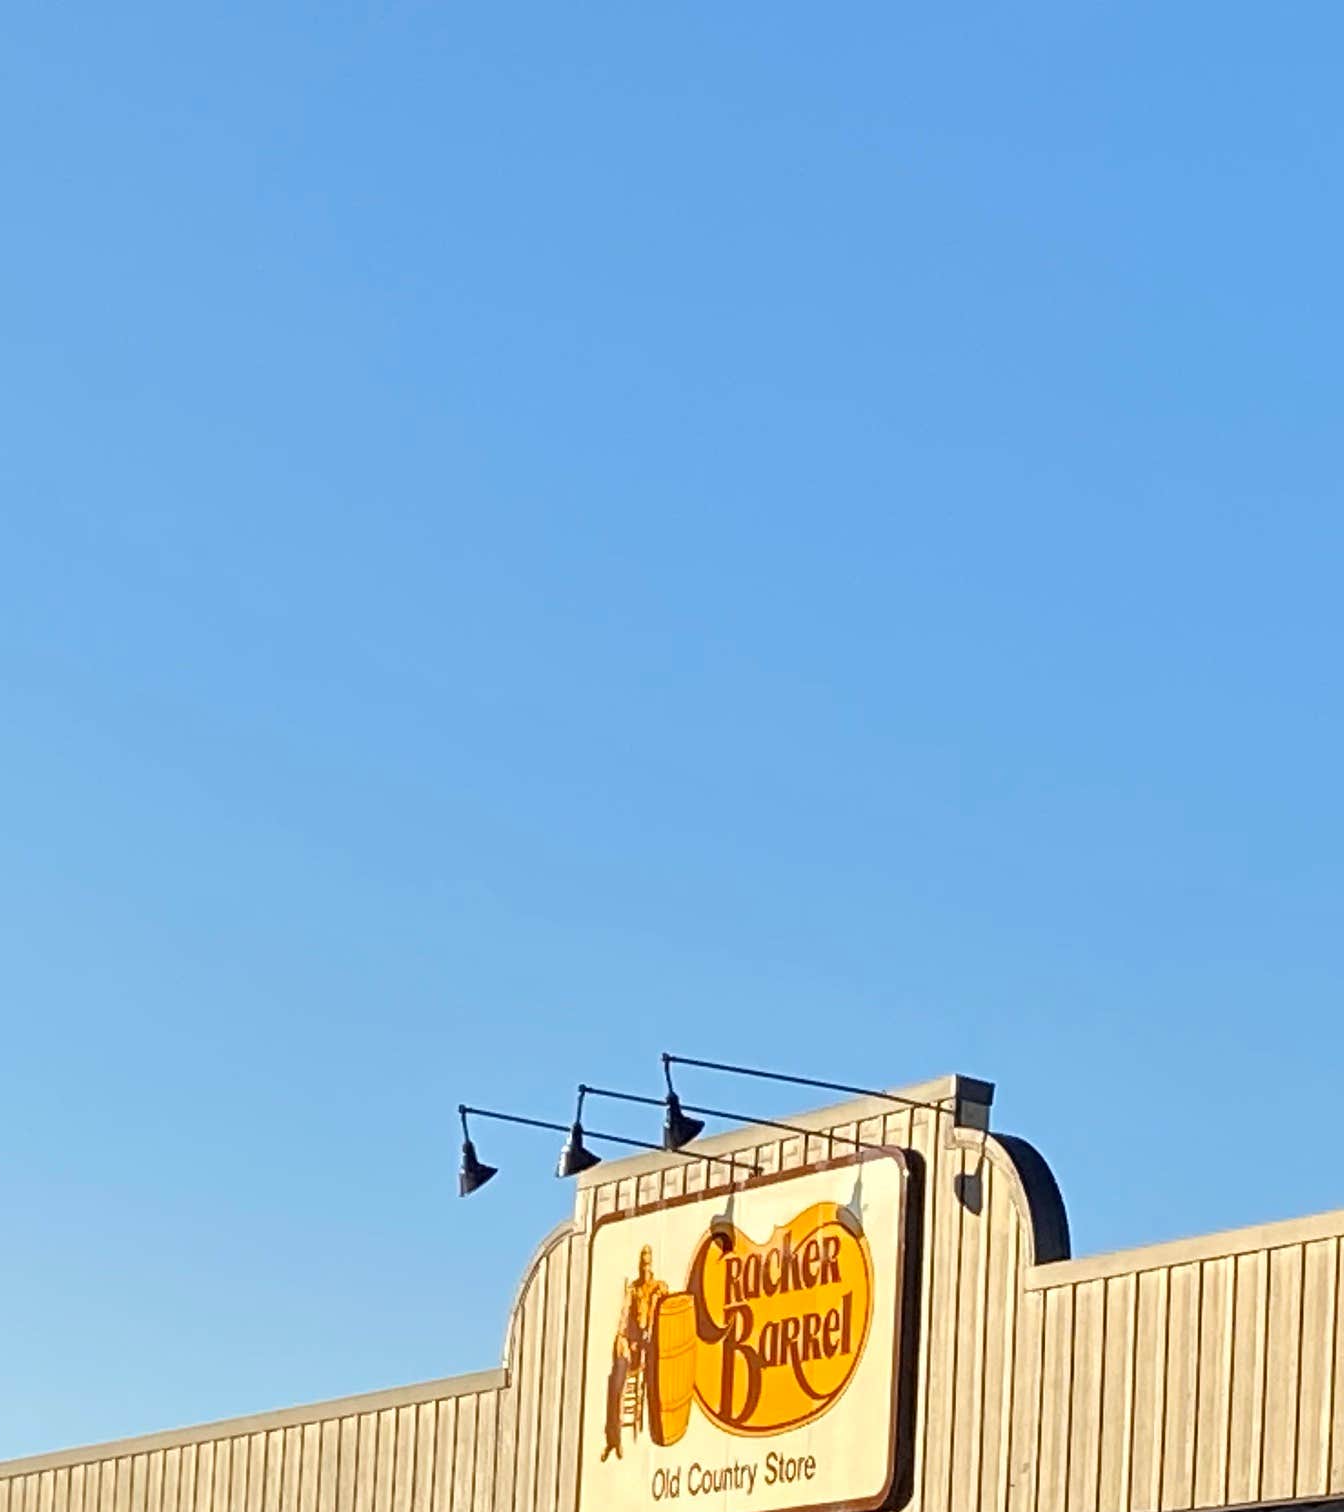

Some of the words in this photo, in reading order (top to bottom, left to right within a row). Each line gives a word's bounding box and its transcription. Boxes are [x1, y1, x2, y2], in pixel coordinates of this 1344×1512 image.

[687, 1230, 842, 1345] Cracker
[719, 1291, 853, 1424] Barrel
[652, 1464, 681, 1501] Old
[688, 1459, 758, 1495] Country
[764, 1451, 817, 1486] Store
